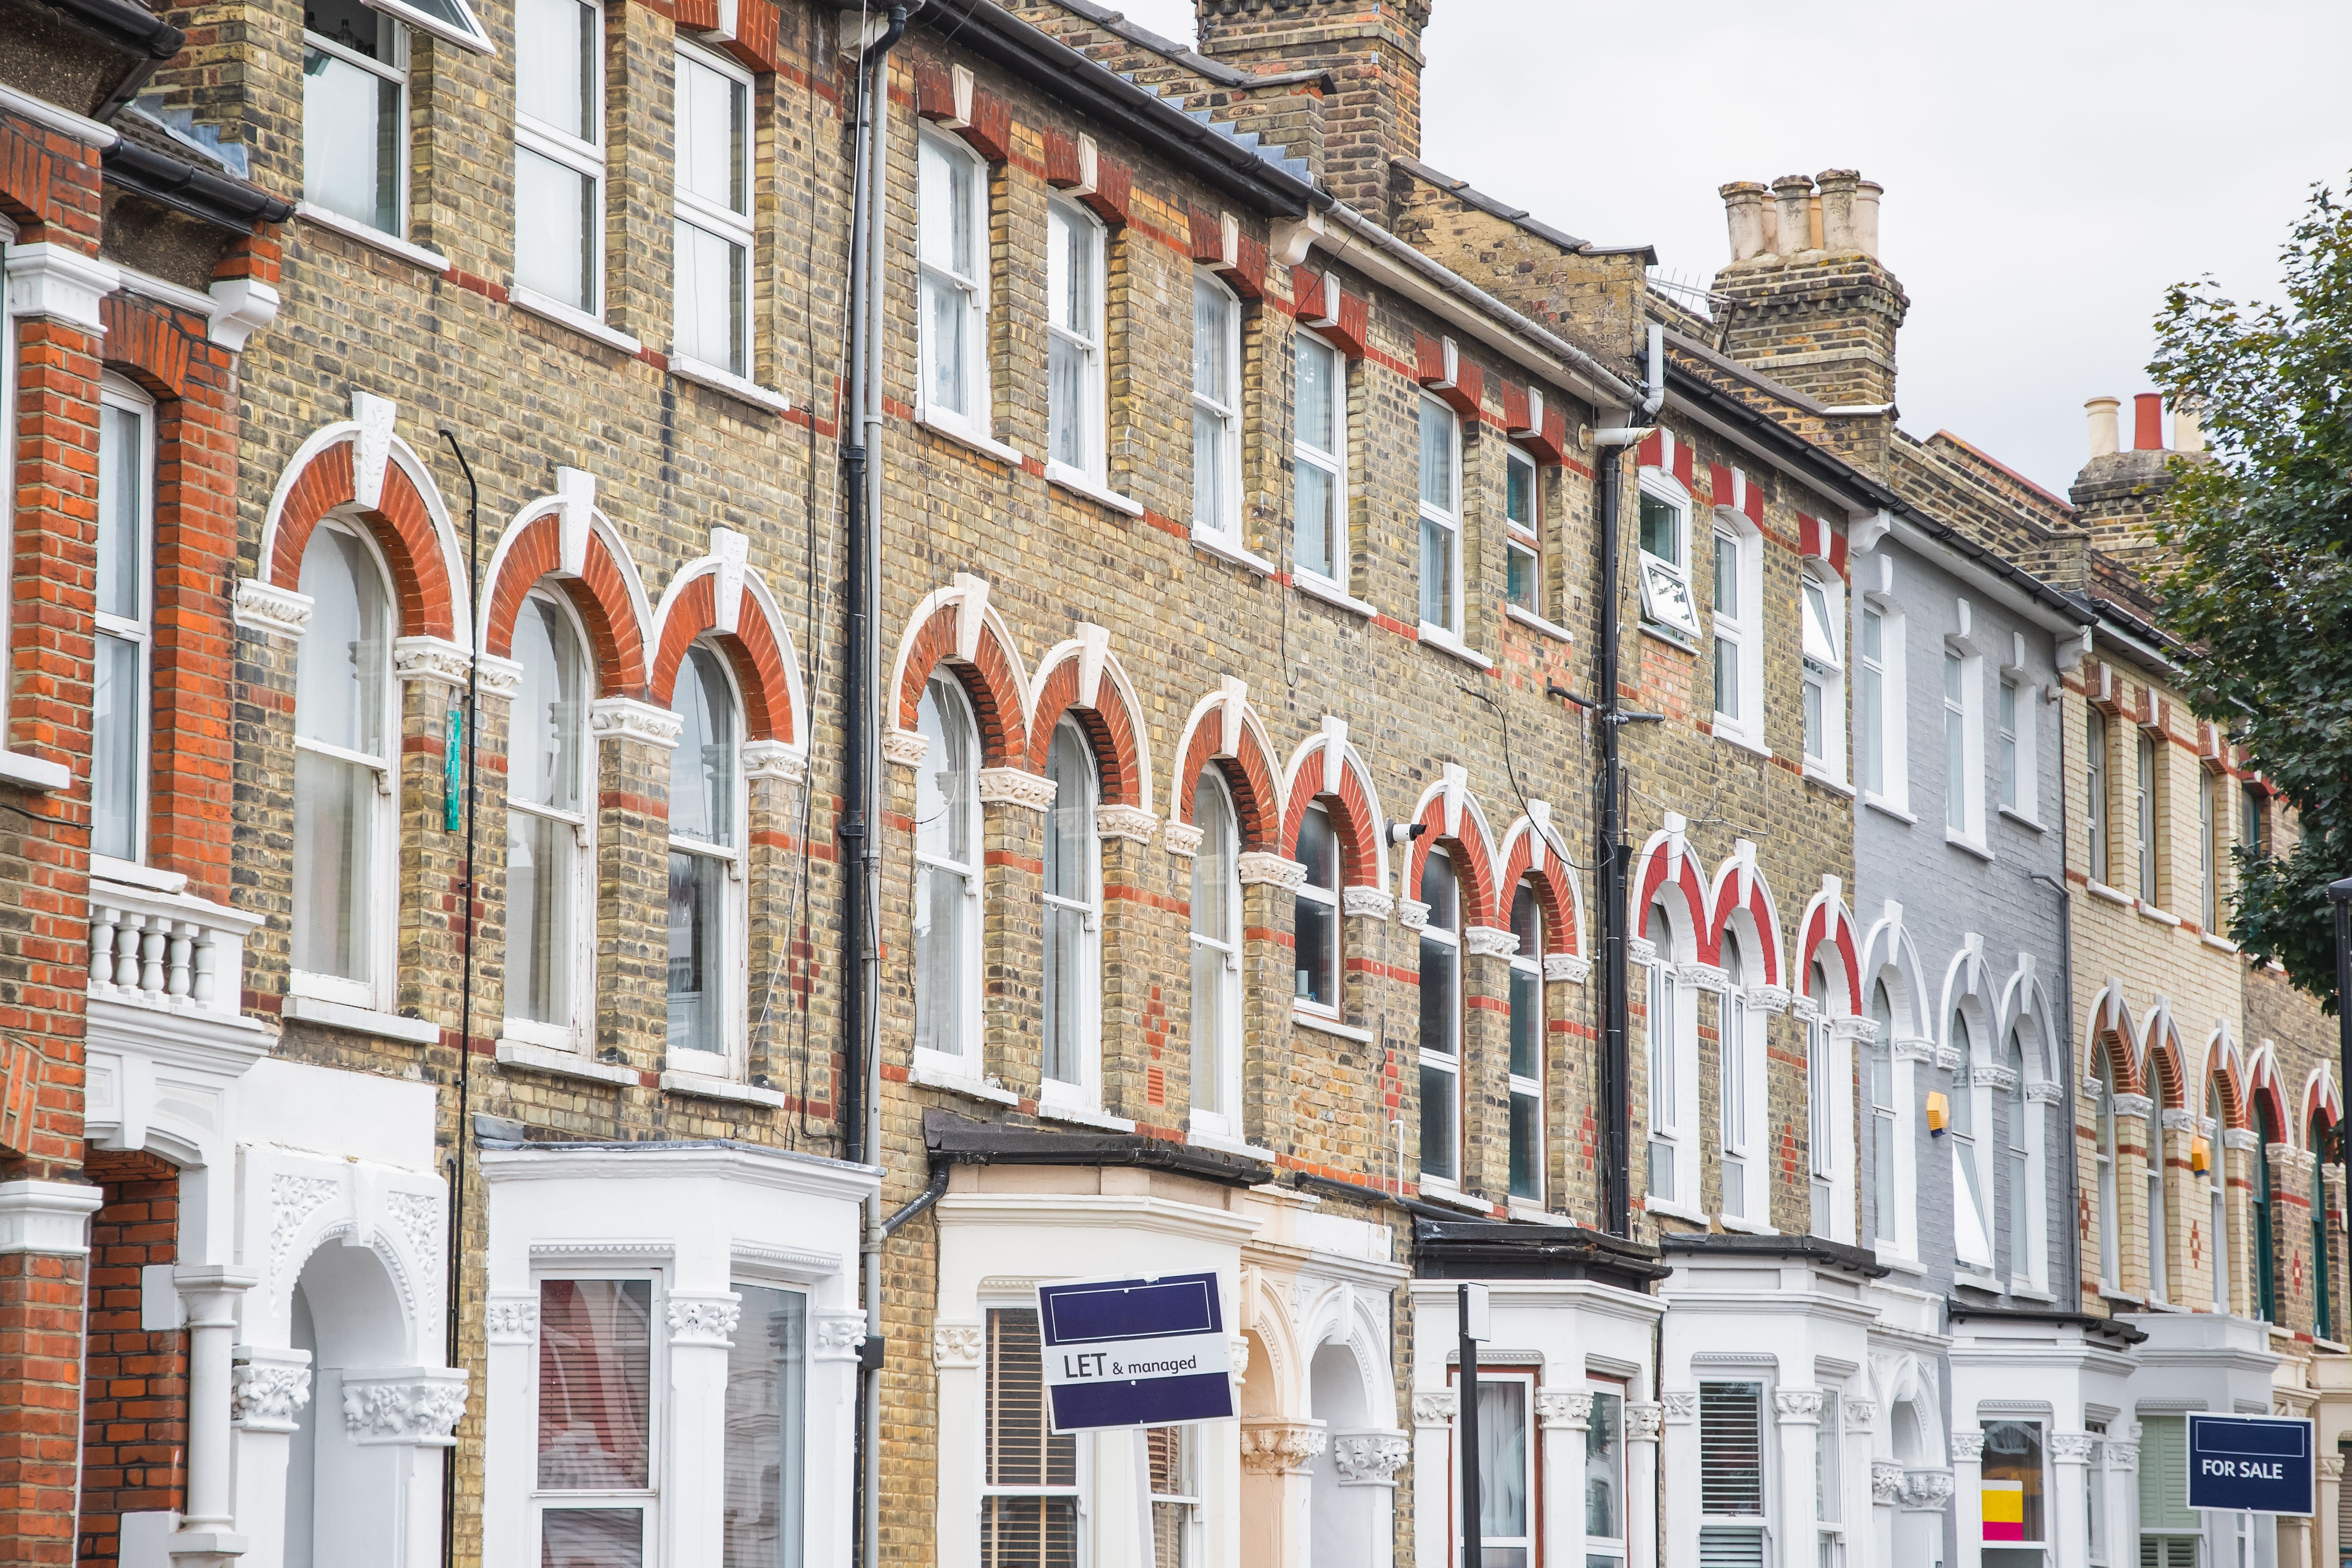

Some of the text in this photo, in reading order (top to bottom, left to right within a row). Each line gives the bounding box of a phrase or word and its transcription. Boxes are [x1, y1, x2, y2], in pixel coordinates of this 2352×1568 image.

[1064, 1353, 1197, 1378] LET & managed
[2202, 1459, 2283, 1479] FOR SALE
